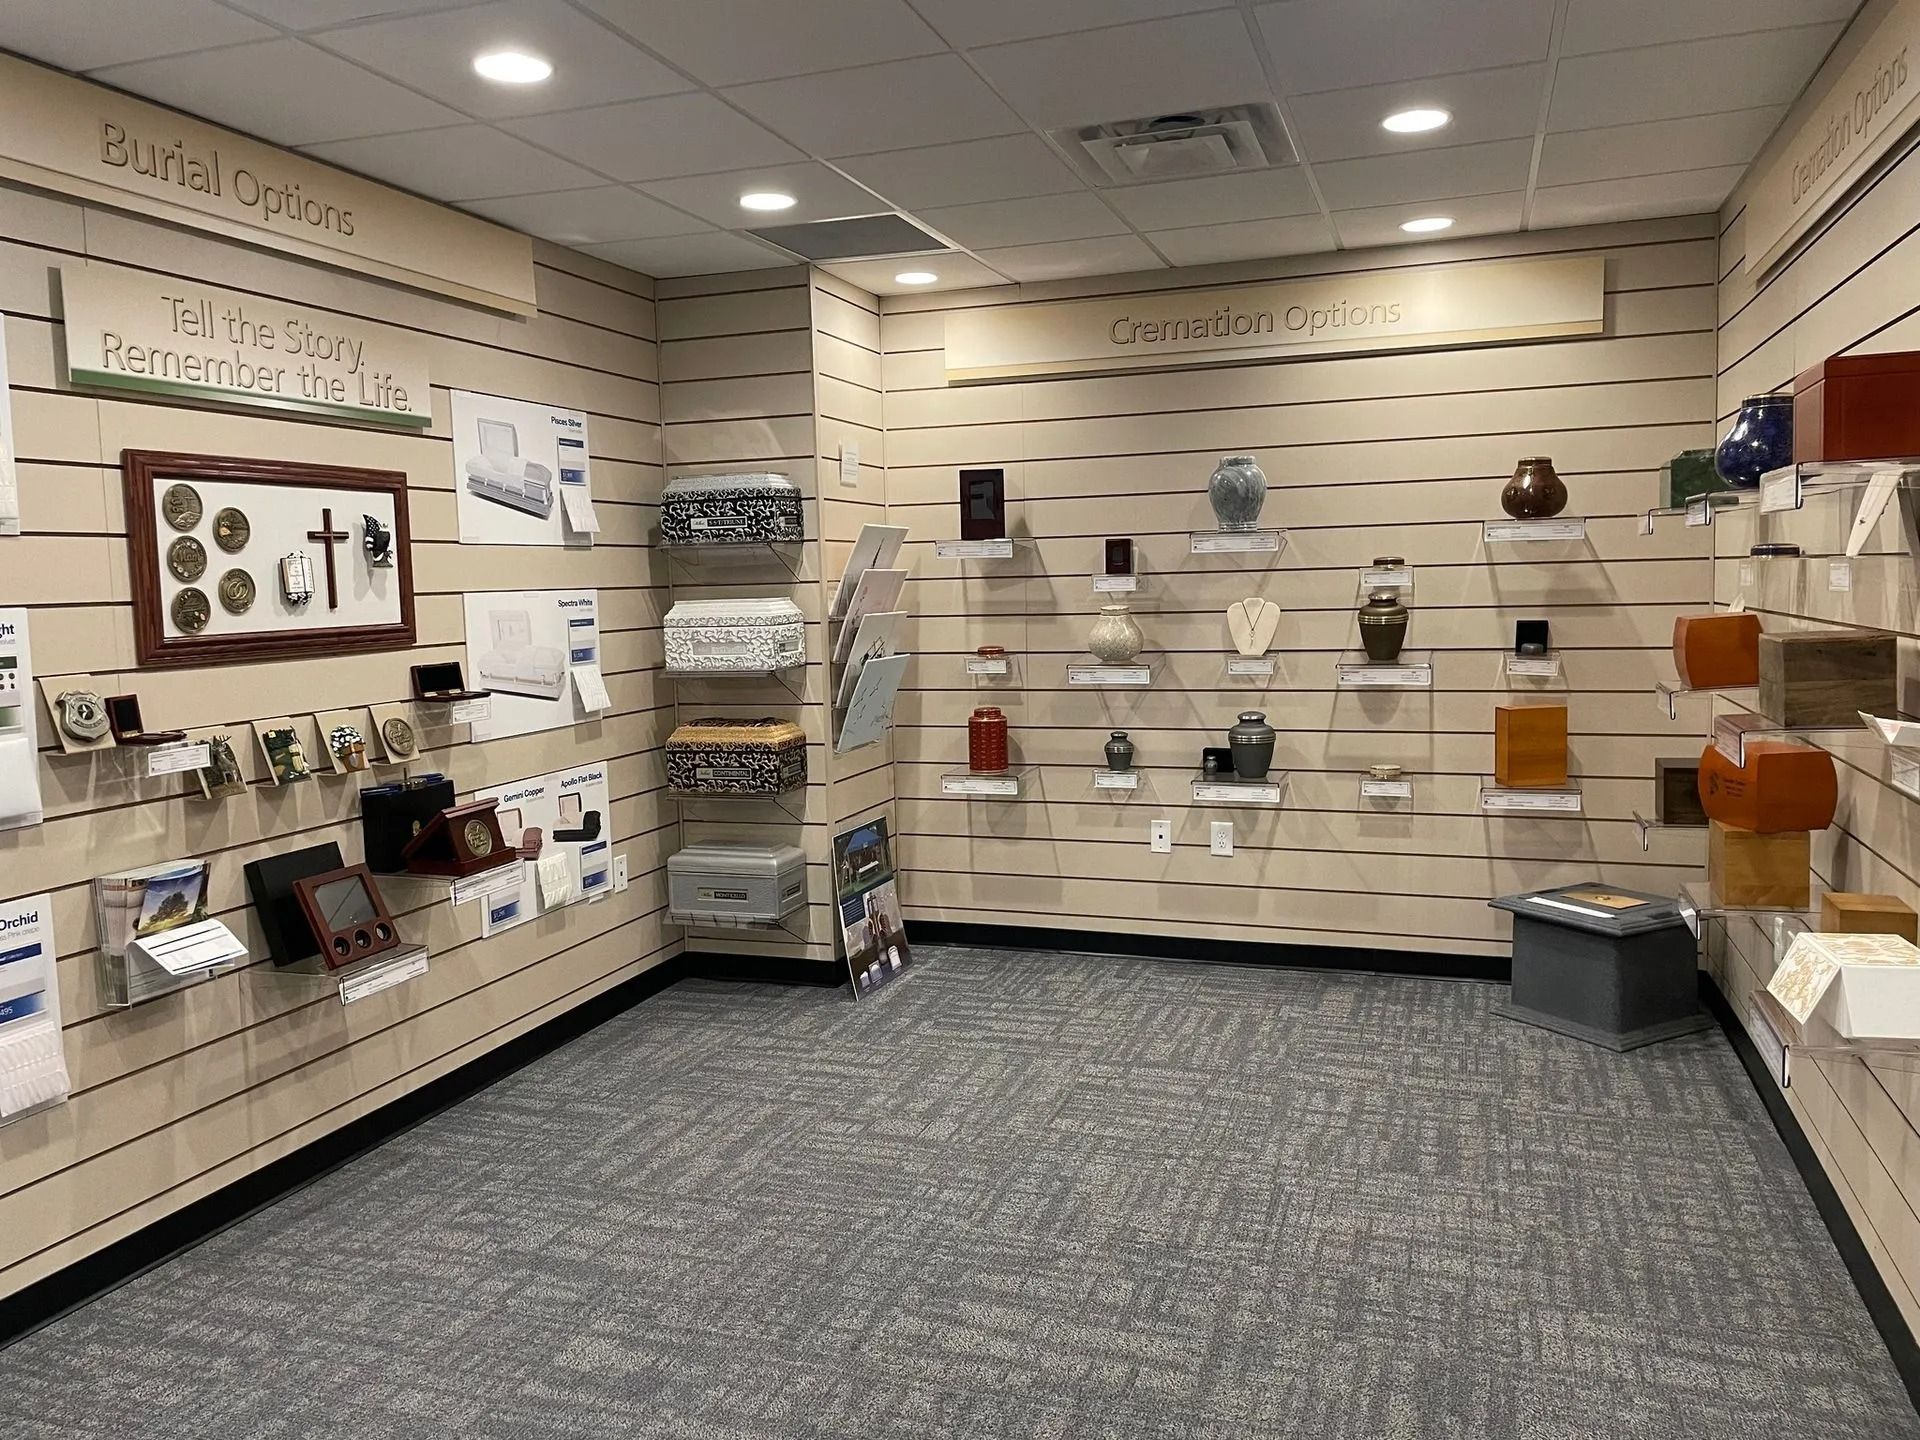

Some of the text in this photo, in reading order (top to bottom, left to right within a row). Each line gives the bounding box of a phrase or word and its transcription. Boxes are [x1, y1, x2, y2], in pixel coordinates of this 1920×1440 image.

[1791, 47, 1908, 205] Cremation Options
[101, 122, 355, 236] Burial Options
[161, 296, 365, 374] Tell the Story.
[1109, 298, 1401, 345] Cremation Options
[101, 331, 412, 413] Remember the Life.
[551, 416, 582, 428] Pisces Silver
[558, 598, 593, 608] Spectra White
[504, 791, 523, 802] Gemini
[525, 787, 544, 798] Copper
[561, 778, 577, 788] Apollo
[578, 776, 588, 784] Flat
[589, 772, 602, 782] Black
[0, 910, 38, 932] Orchid
